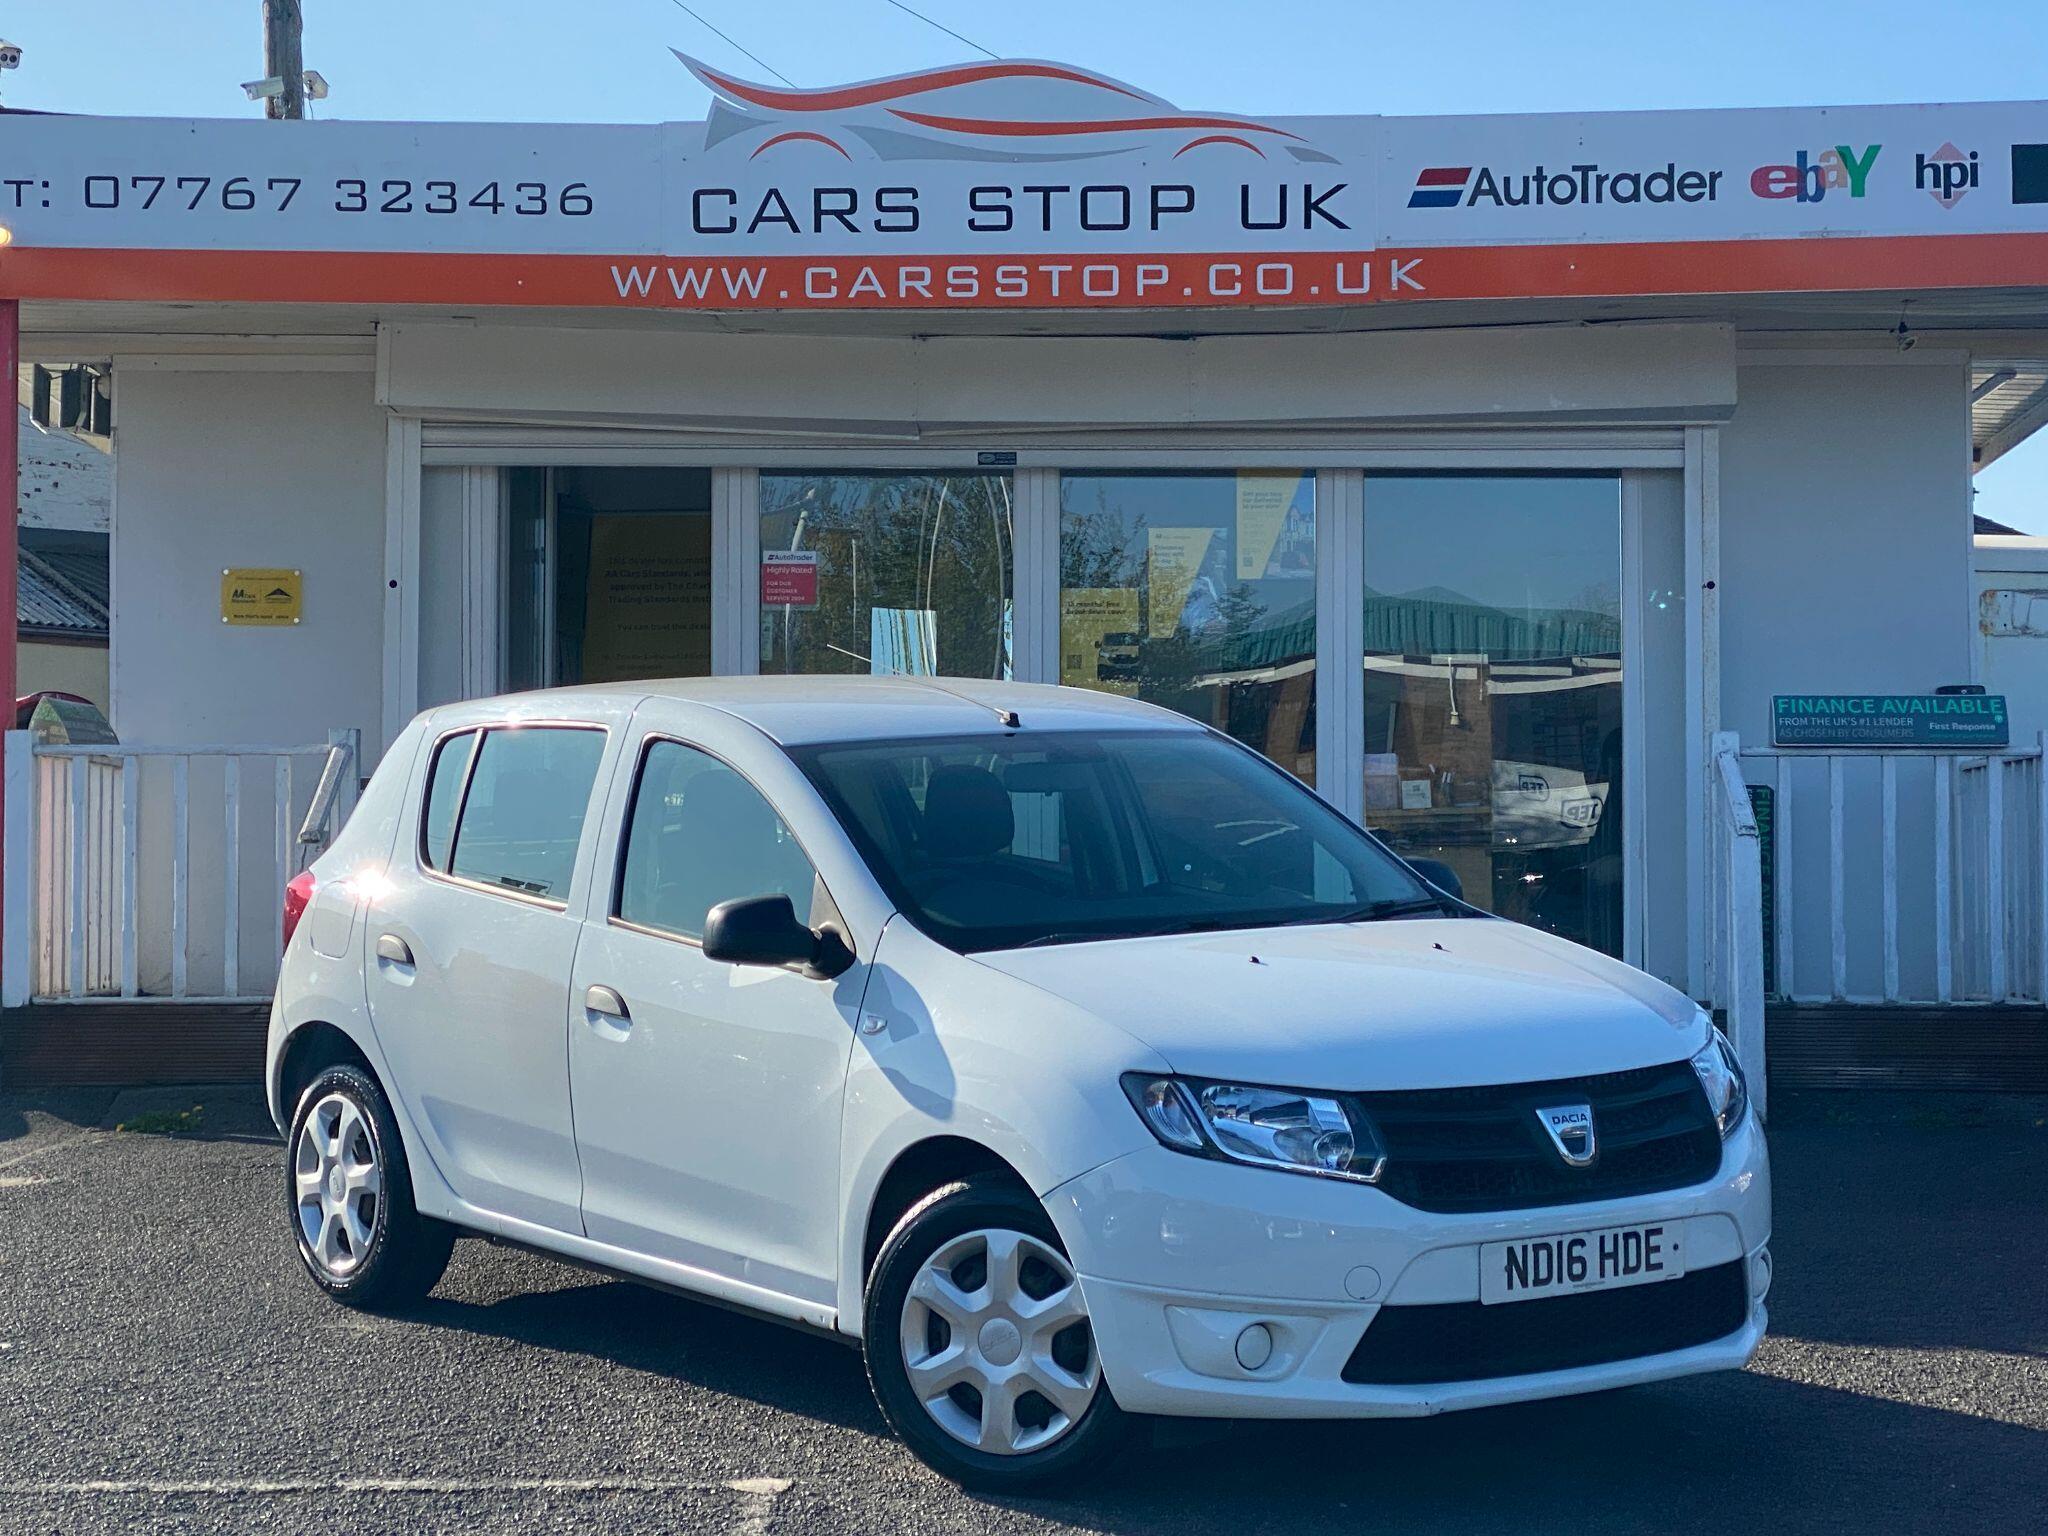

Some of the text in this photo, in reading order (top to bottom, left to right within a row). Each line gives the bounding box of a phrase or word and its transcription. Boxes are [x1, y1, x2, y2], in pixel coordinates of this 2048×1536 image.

[4, 175, 593, 216] T: 07767 323436
[1466, 162, 1723, 208] AutoTrader
[1915, 150, 1979, 200] hpi
[692, 184, 1352, 234] CARS STOP UK
[610, 258, 1427, 300] WWW.CARSSTOP.CO.UK
[766, 566, 813, 574] Highly Rated
[1777, 698, 2004, 715] FINANCE AVAILABLE
[1778, 717, 1914, 726] FROM THE UK'S #1 LENDER
[1929, 722, 1996, 731] First Response
[1552, 1112, 1588, 1125] DACIA
[1506, 1227, 1664, 1291] ND16 HDE
